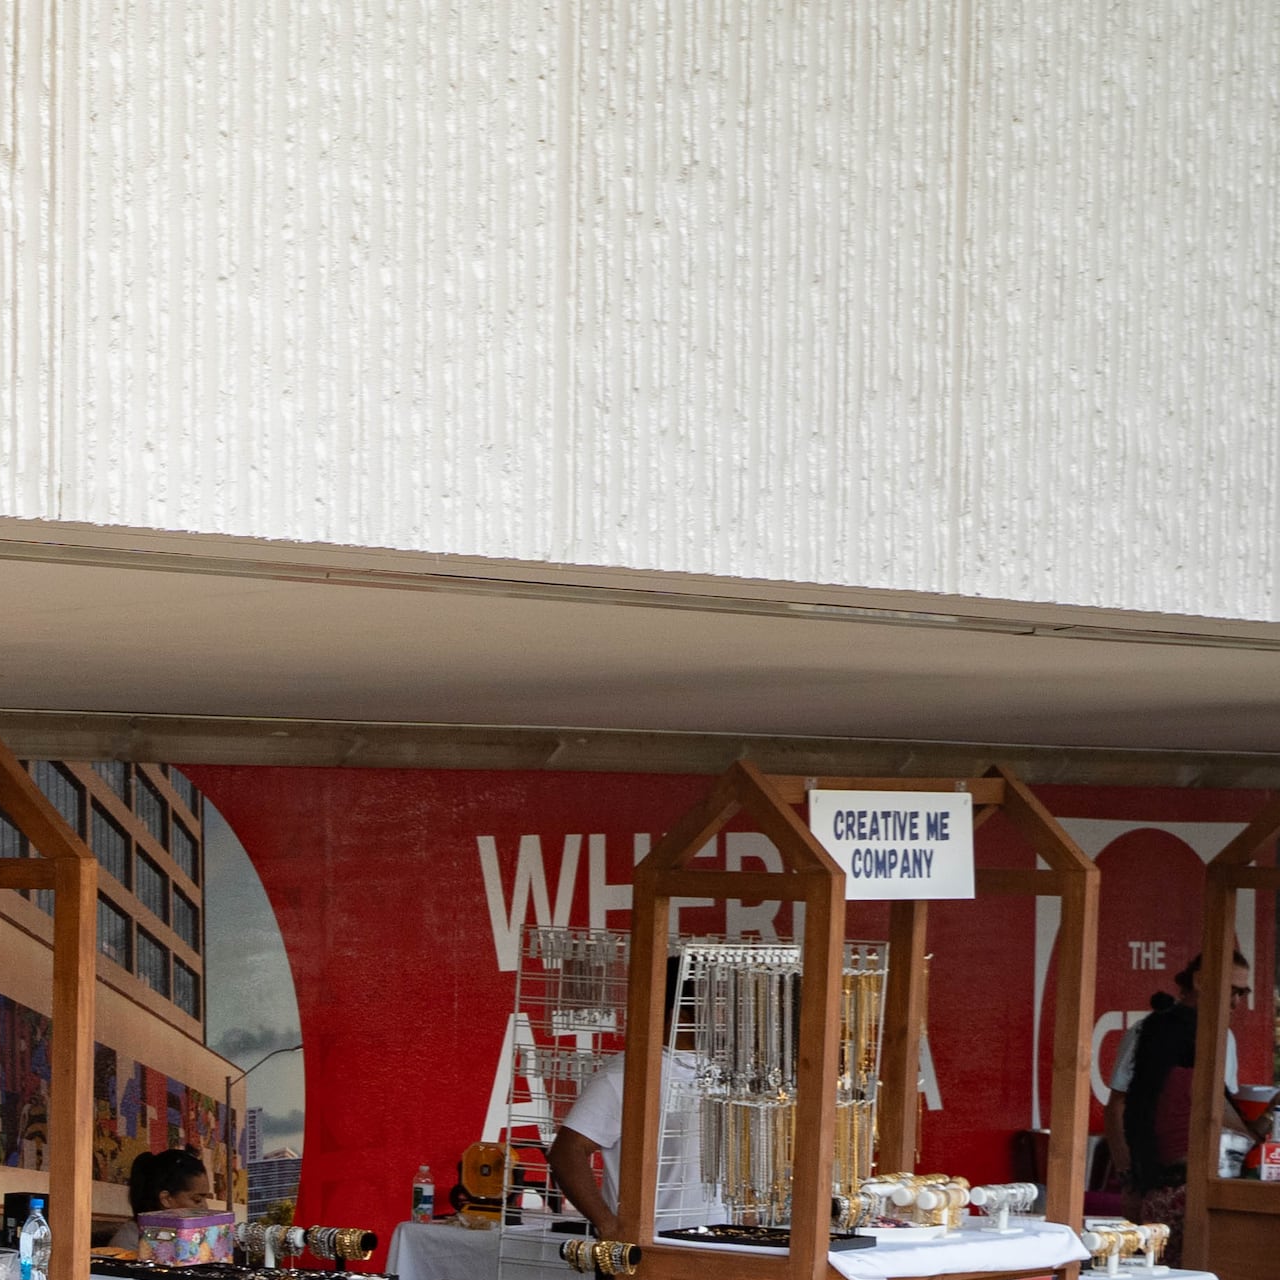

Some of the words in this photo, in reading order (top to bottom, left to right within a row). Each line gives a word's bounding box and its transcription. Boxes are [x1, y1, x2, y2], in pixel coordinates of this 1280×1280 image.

[833, 810, 919, 842] CREATIVE
[925, 811, 950, 841] ME
[851, 848, 935, 879] COMPANY
[1128, 941, 1166, 970] THE
